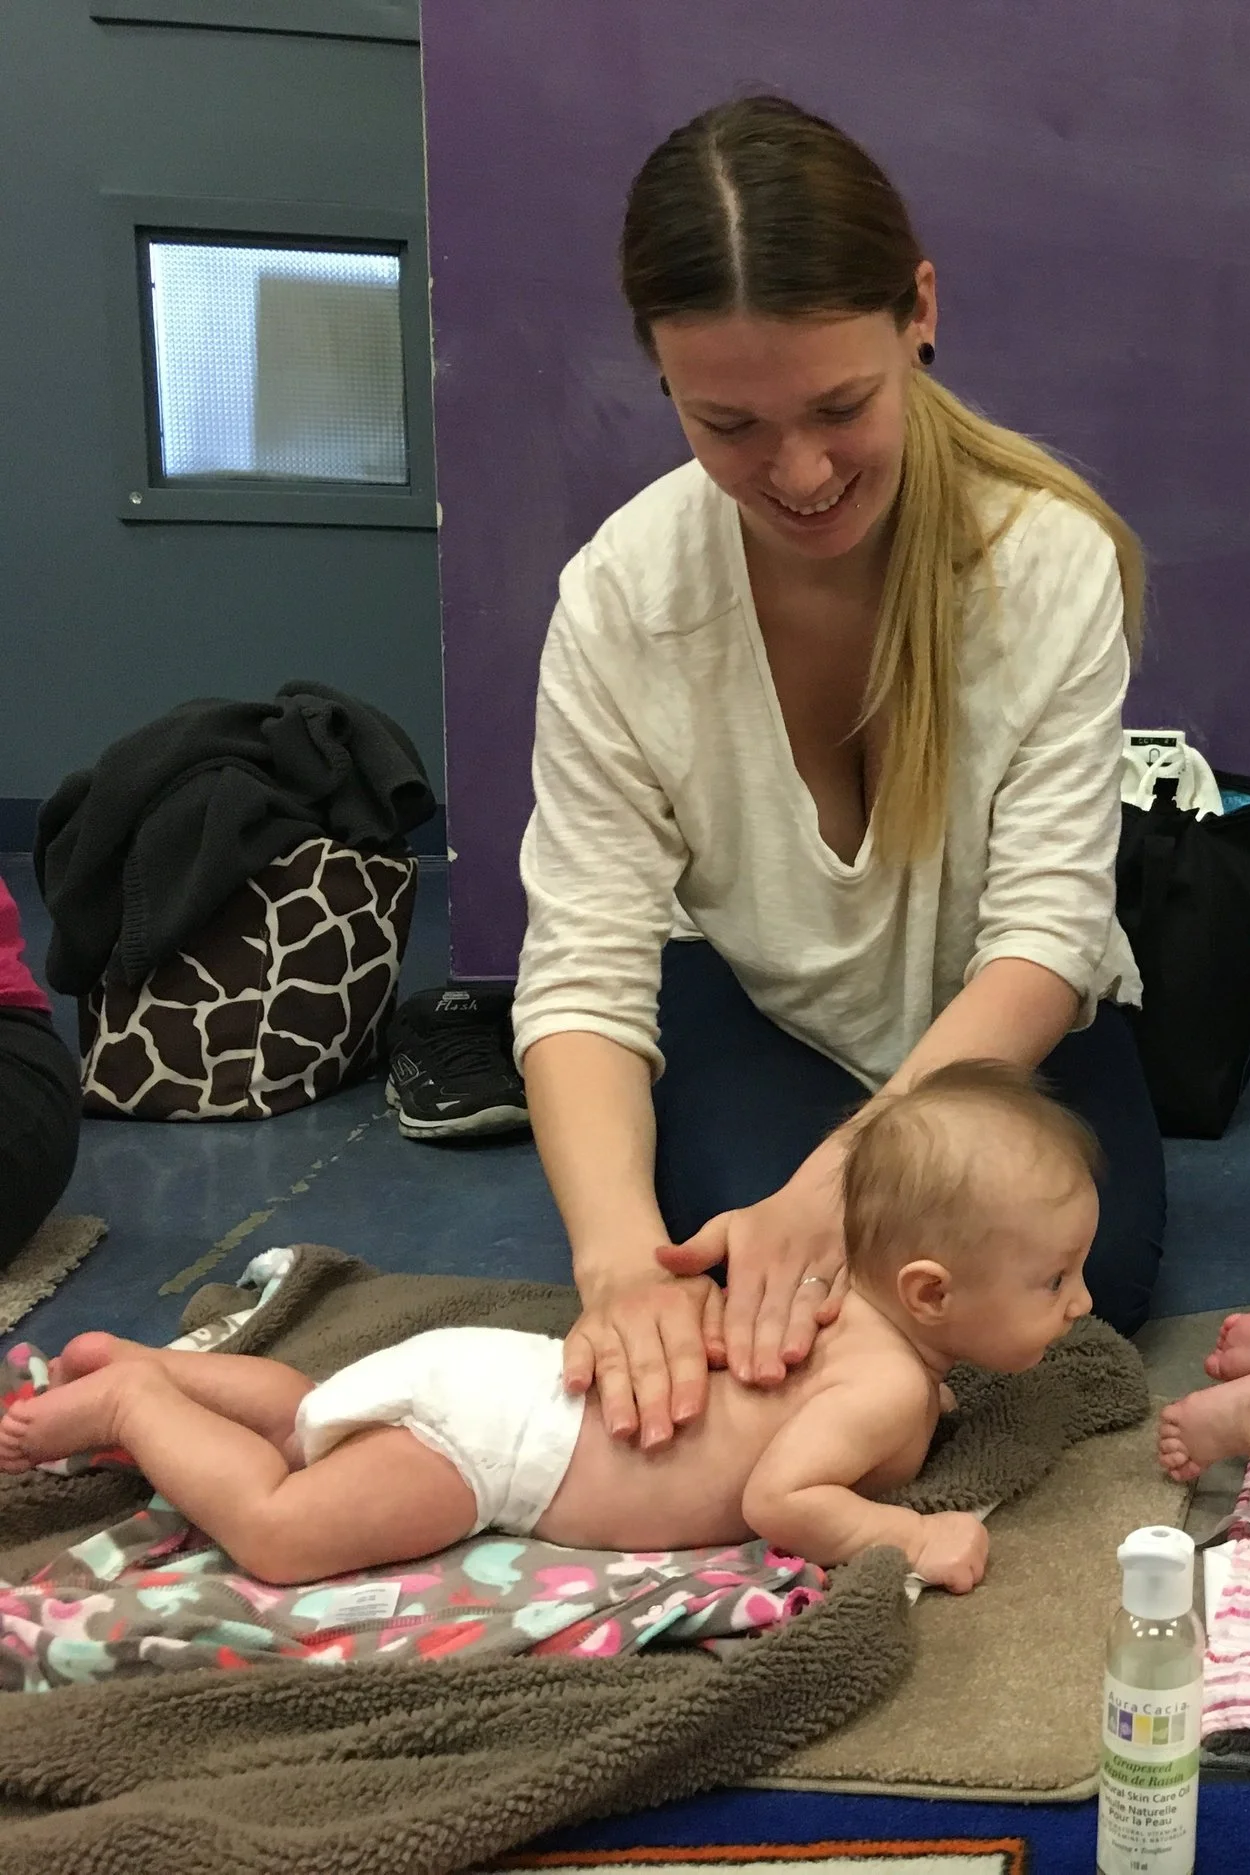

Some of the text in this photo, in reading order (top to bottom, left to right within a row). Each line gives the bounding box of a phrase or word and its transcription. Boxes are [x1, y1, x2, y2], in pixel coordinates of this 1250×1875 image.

[1108, 1691, 1187, 1715] Aura Cacia
[1113, 1755, 1173, 1774] Grapeseed
[1131, 1775, 1145, 1787] de
[1148, 1773, 1184, 1787] Raisin
[1127, 1791, 1149, 1803] Skin
[1152, 1793, 1176, 1803] Care
[1178, 1784, 1190, 1798] Oil
[1109, 1807, 1129, 1822] Pour
[1132, 1816, 1142, 1826] la
[1145, 1817, 1172, 1827] Peau
[1128, 1805, 1177, 1818] Naturelle
